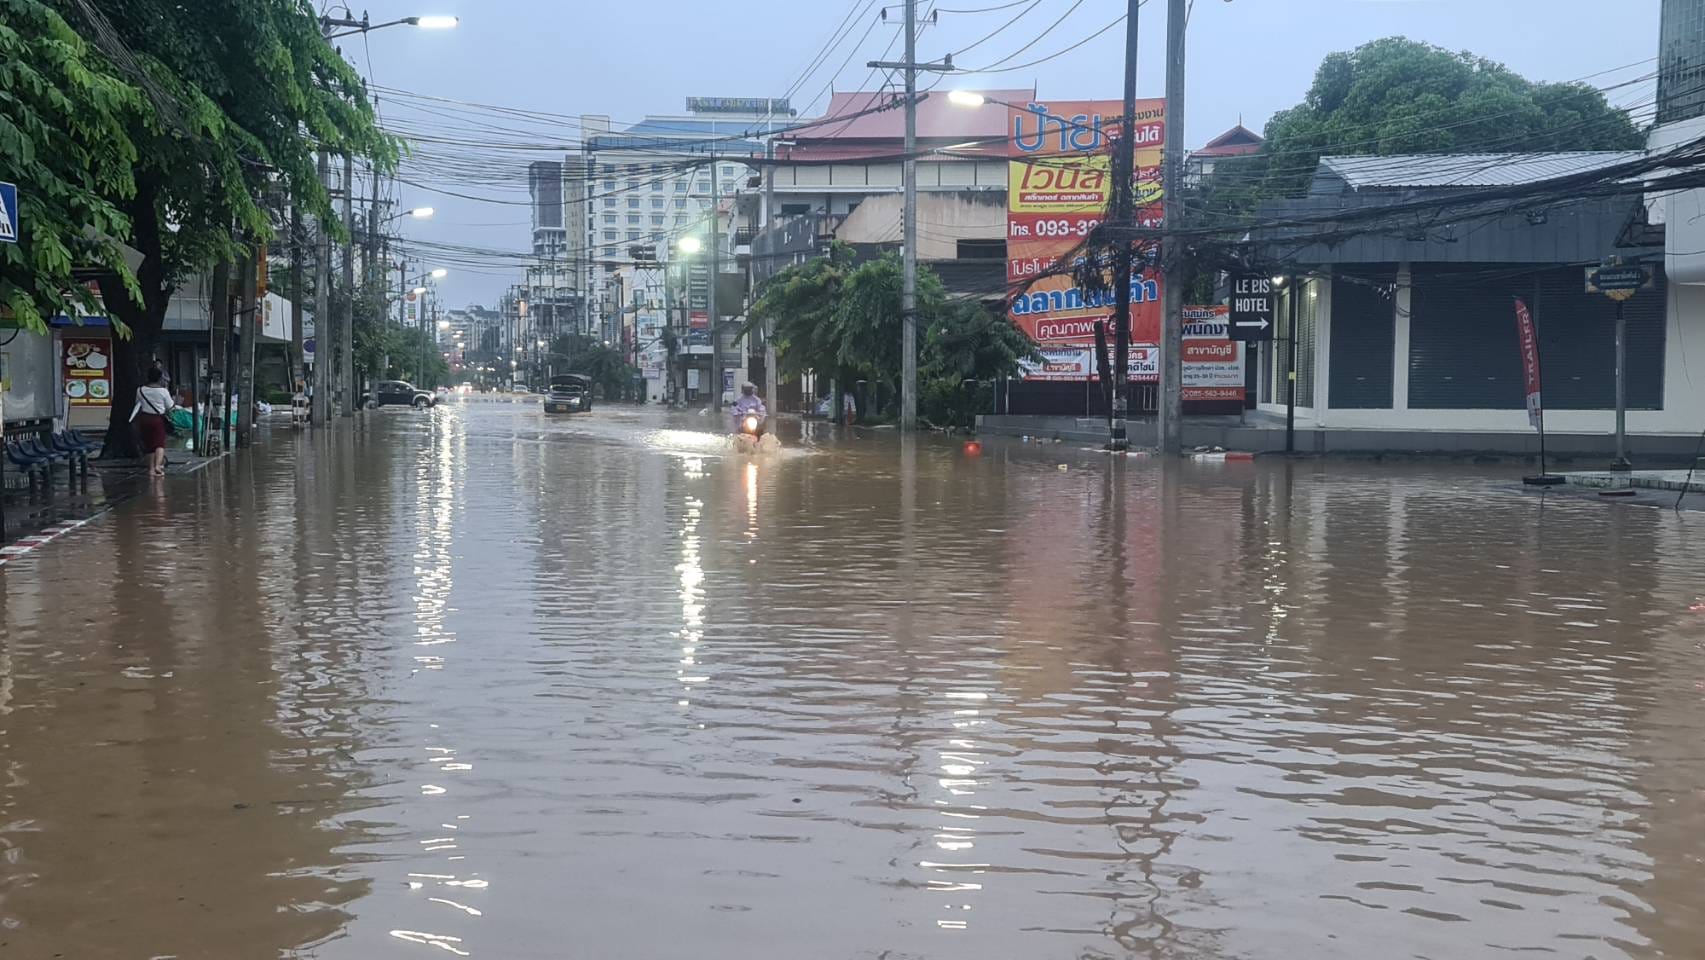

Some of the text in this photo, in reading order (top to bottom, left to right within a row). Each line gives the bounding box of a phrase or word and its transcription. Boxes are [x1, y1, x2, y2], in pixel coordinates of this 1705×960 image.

[1015, 102, 1101, 152] ป้าย
[1236, 279, 1249, 293] LE
[1235, 298, 1270, 312] HOTEL
